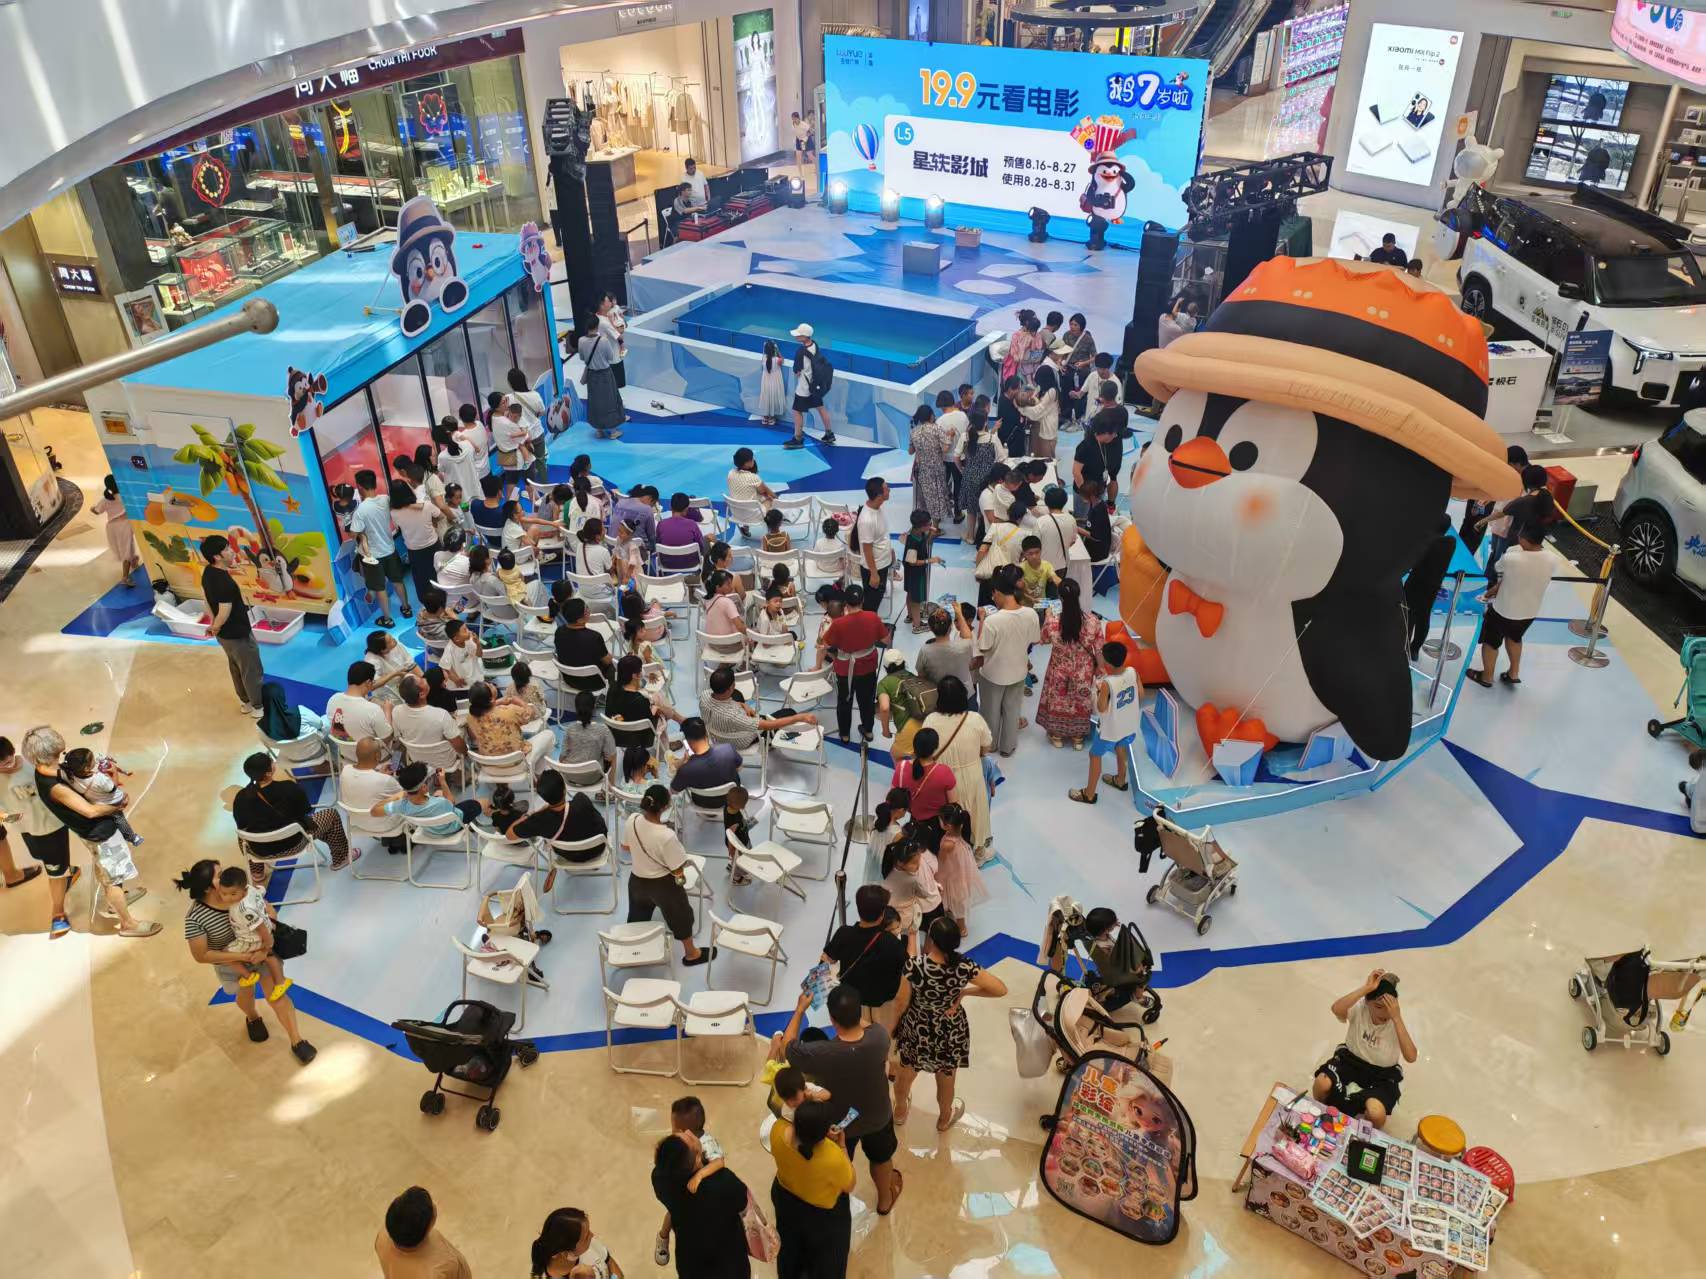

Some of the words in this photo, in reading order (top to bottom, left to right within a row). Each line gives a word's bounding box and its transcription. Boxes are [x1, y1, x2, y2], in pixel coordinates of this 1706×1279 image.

[920, 68, 1079, 118] 19.9元看电影
[895, 125, 912, 142] L5
[1003, 155, 1077, 174] 预售8.16-8.27
[1002, 173, 1076, 192] 使用8.28-8.31
[1116, 686, 1135, 709] 23
